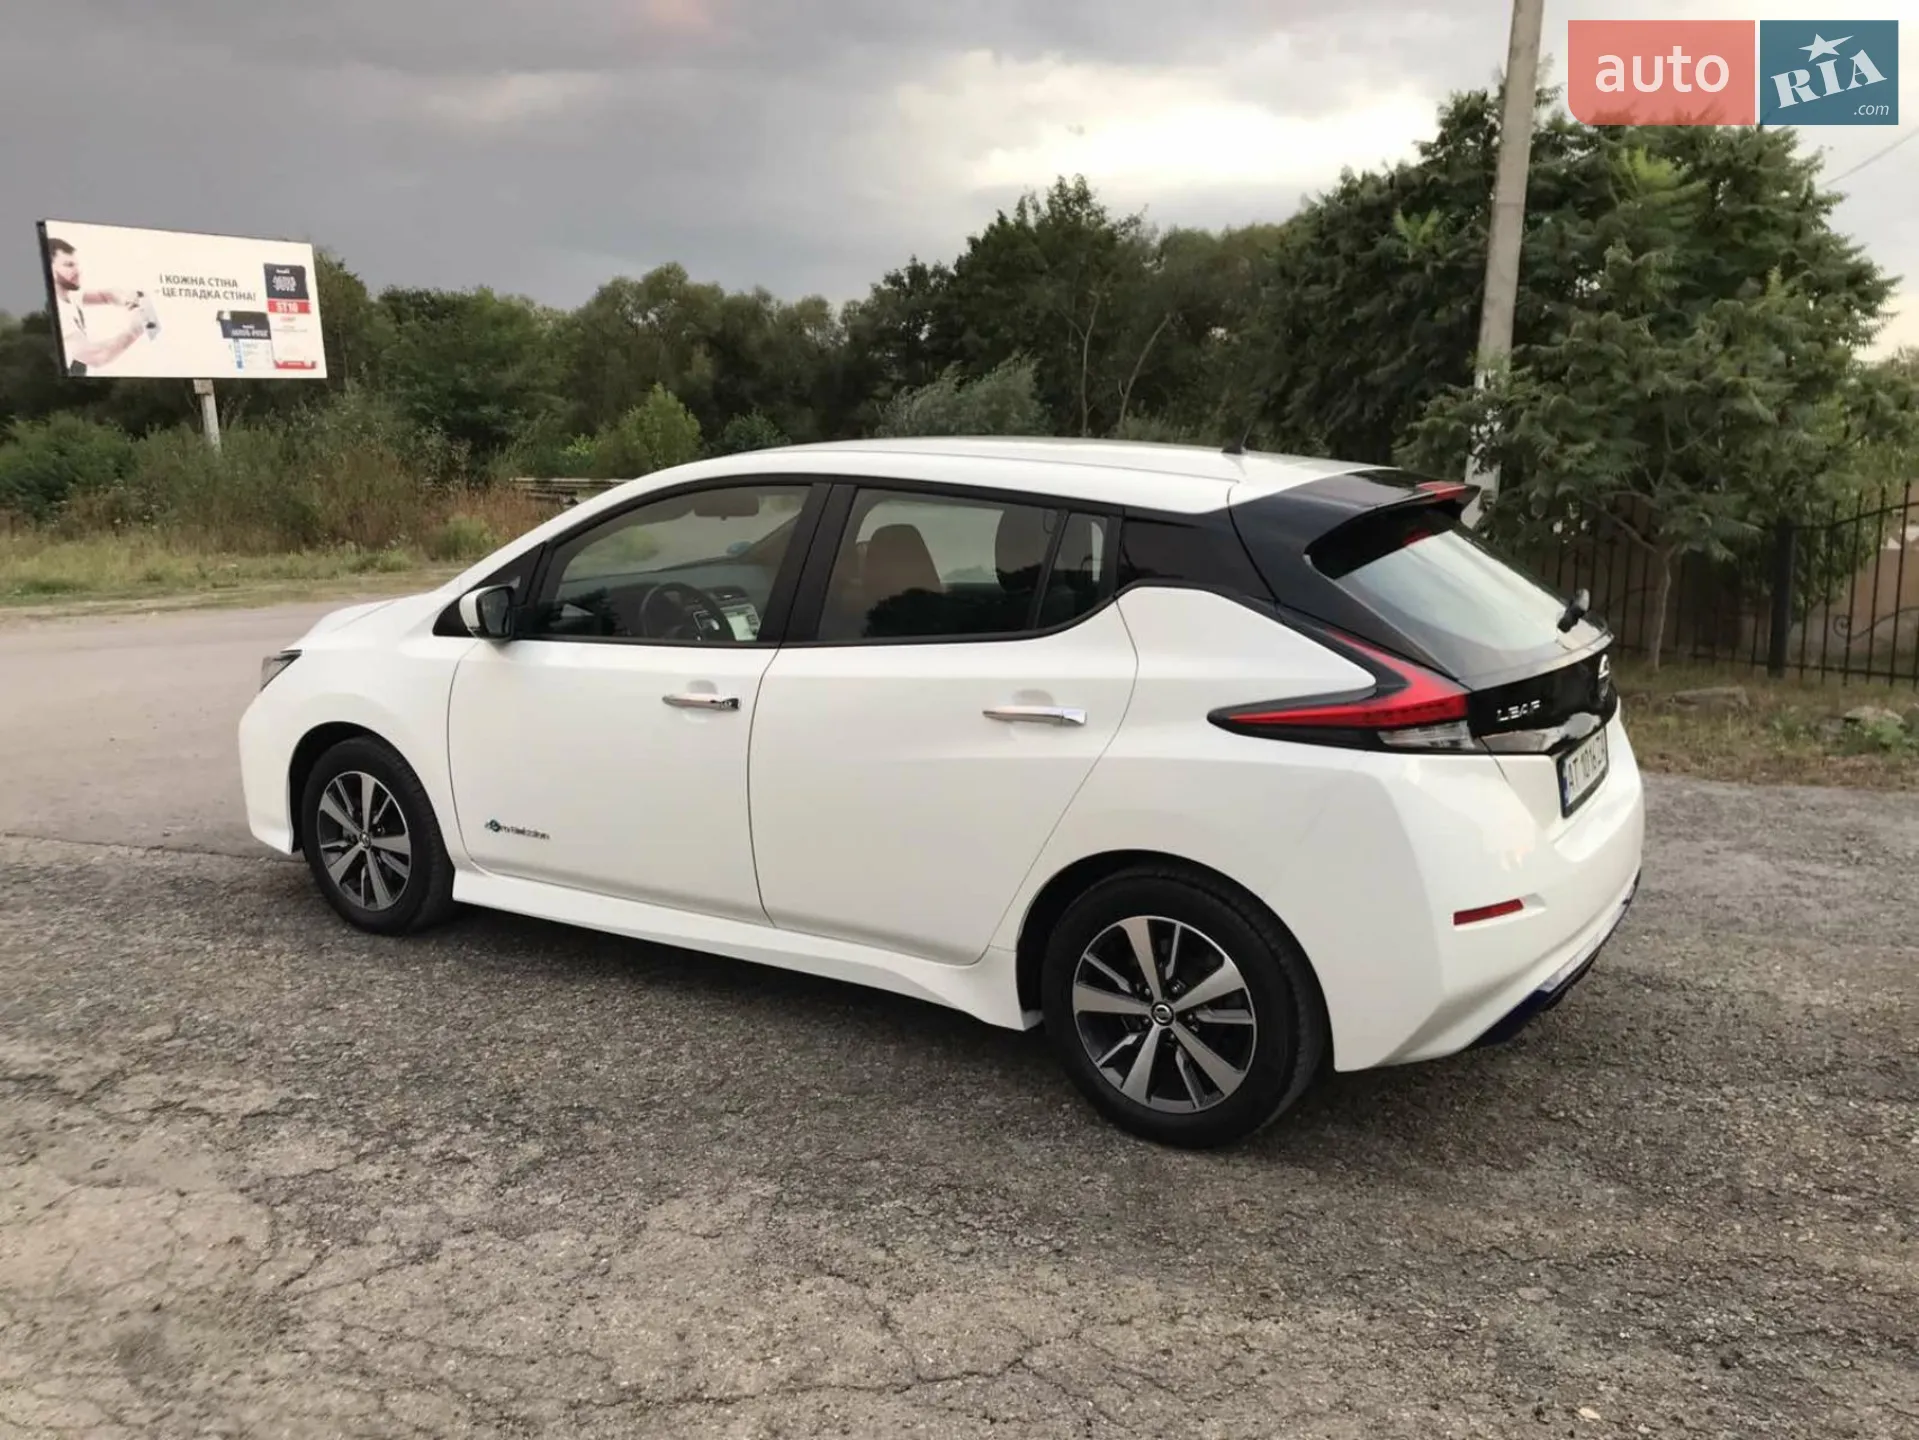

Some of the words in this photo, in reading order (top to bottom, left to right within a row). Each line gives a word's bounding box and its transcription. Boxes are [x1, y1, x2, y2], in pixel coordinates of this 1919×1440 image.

[164, 274, 206, 286] КОЖНА
[207, 277, 239, 288] СТІНА
[162, 287, 177, 299] ЦЕ
[178, 288, 221, 301] ГЛАДКА
[222, 290, 257, 302] СТІНА!
[1496, 699, 1541, 722] LEAF
